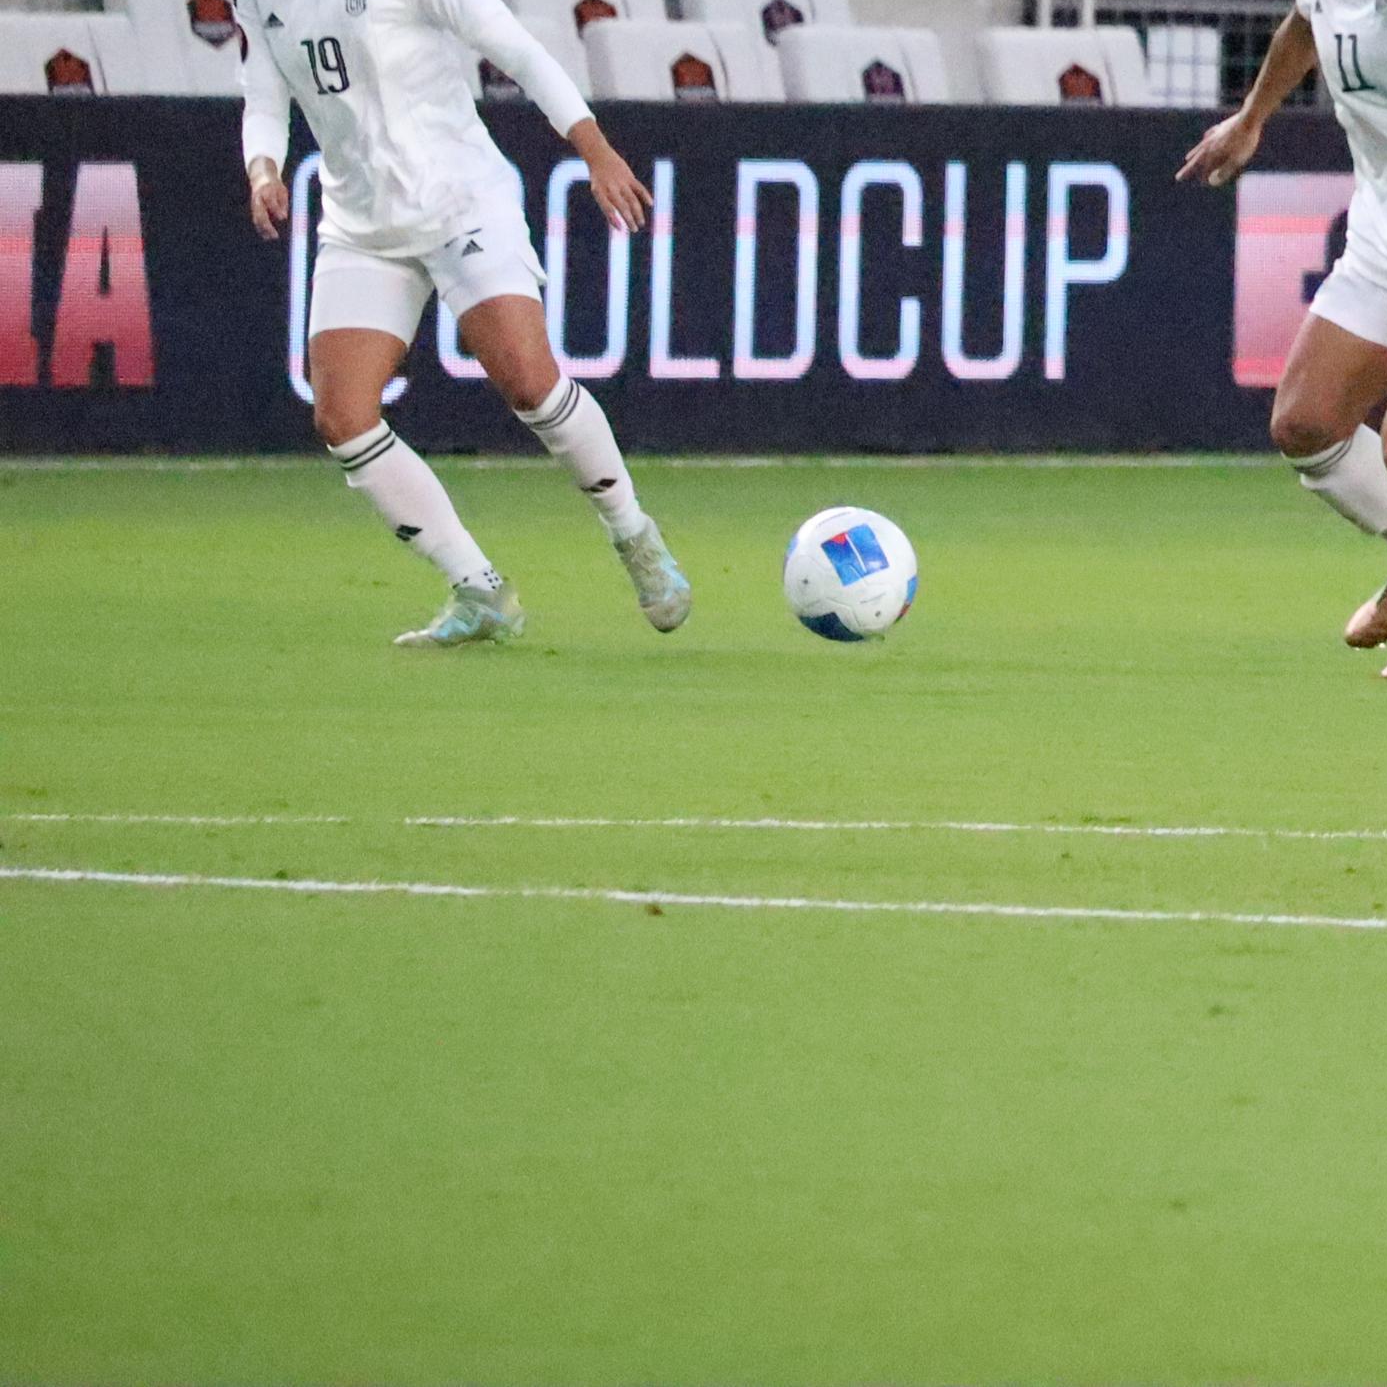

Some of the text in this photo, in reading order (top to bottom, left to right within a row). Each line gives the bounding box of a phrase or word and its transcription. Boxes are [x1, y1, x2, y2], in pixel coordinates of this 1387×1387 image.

[300, 36, 350, 96] 19
[1333, 33, 1376, 93] 11
[288, 151, 1129, 404] OLDCUP
